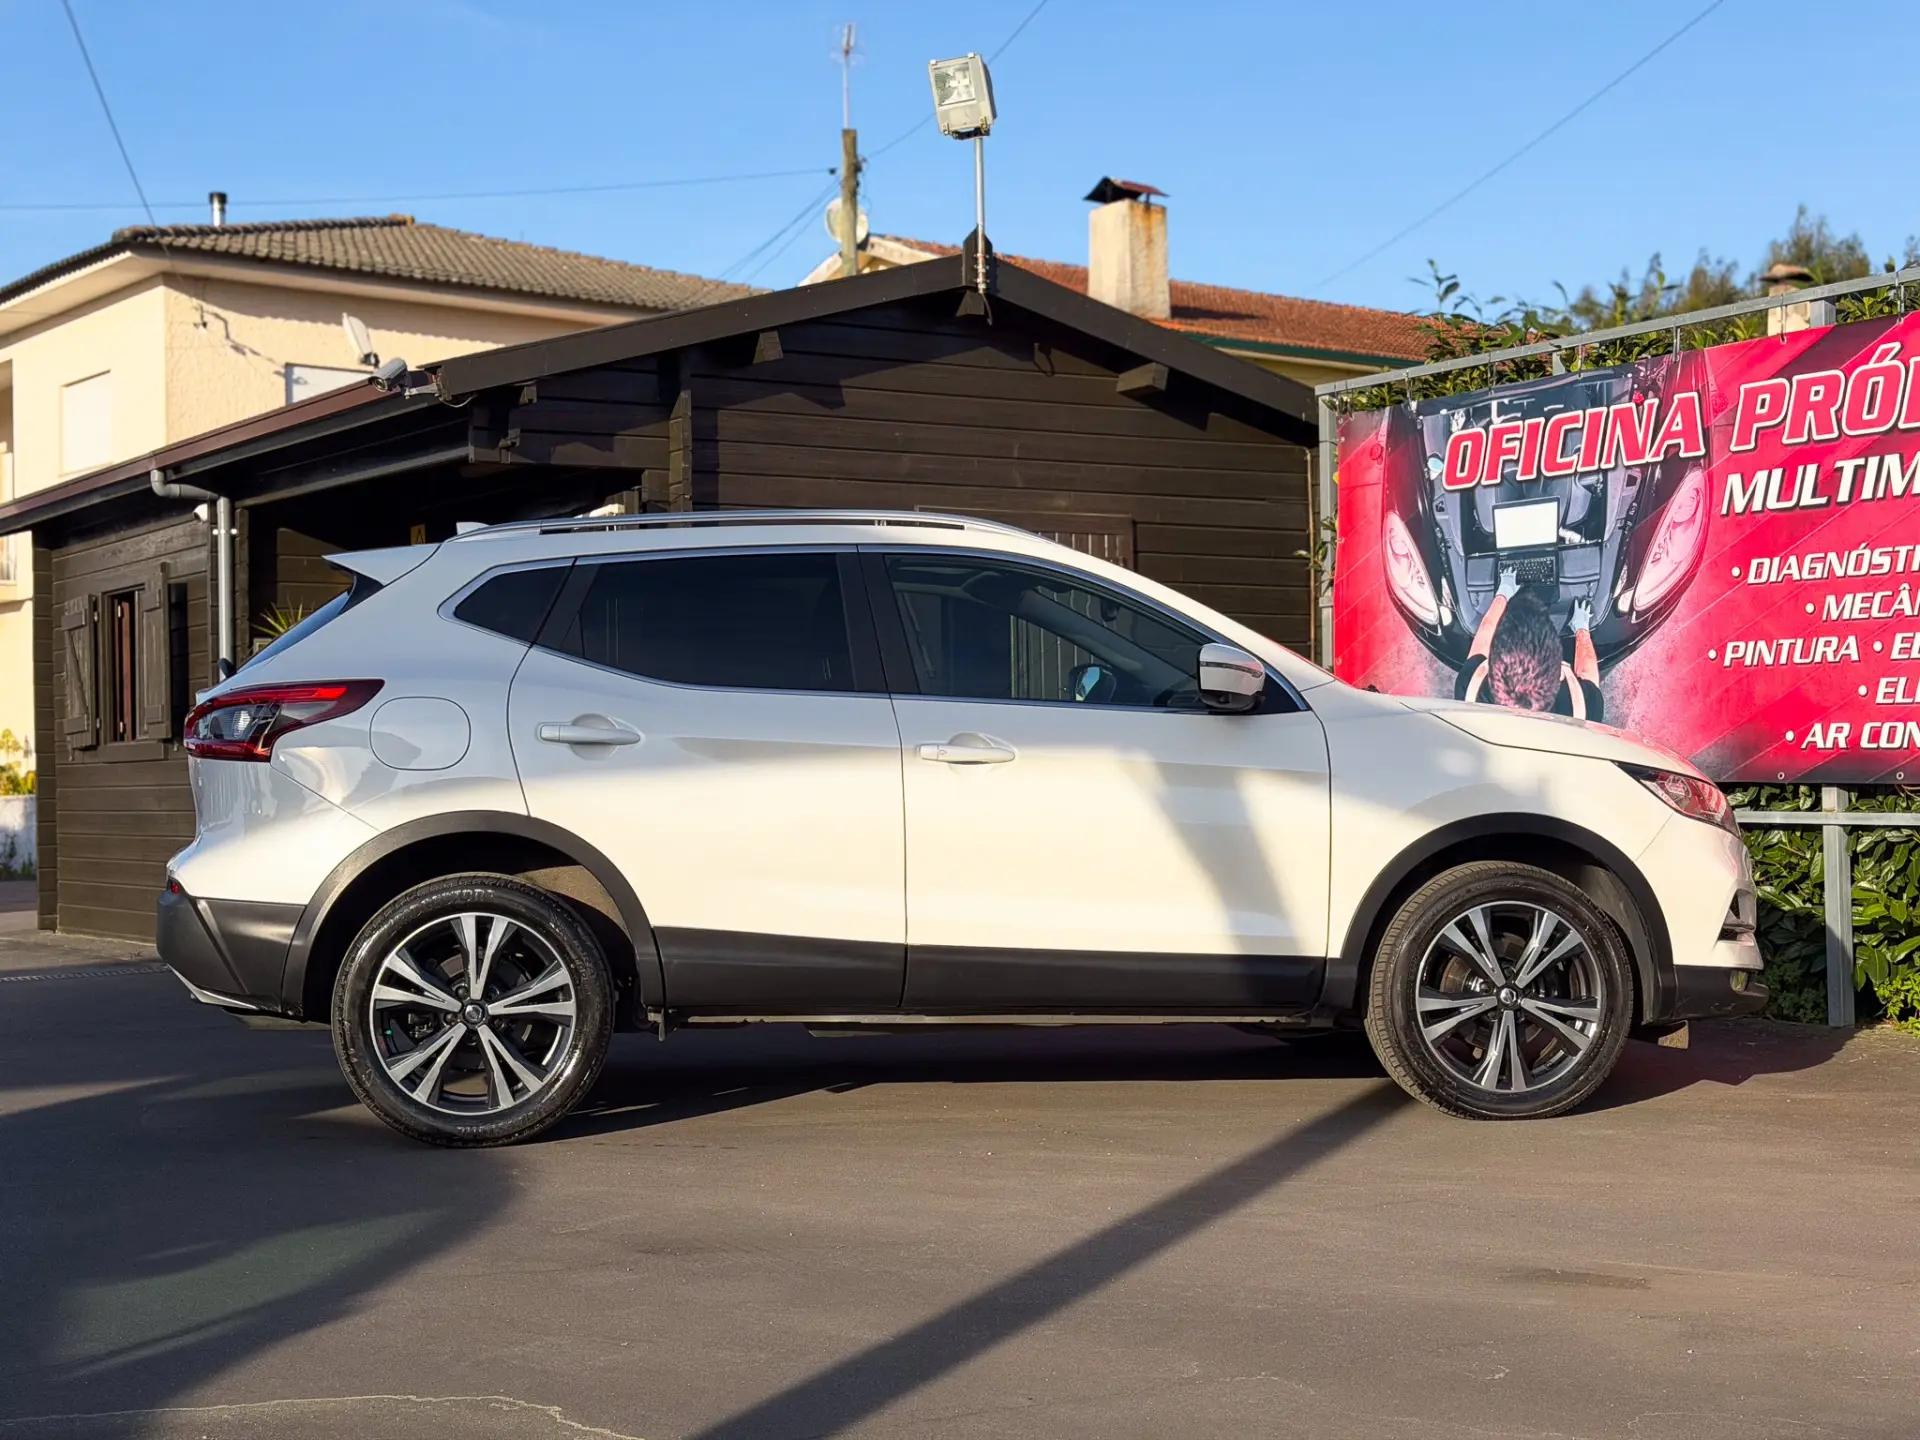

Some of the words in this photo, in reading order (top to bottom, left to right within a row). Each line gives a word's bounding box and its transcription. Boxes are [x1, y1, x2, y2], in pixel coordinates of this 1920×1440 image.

[1442, 392, 1706, 490] OFICINA
[1720, 451, 1920, 515] MULTIM
[1822, 583, 1920, 622] MECÂ
[1723, 635, 1860, 667] PINTURA
[1875, 677, 1920, 704] EL
[1800, 722, 1851, 749] AR
